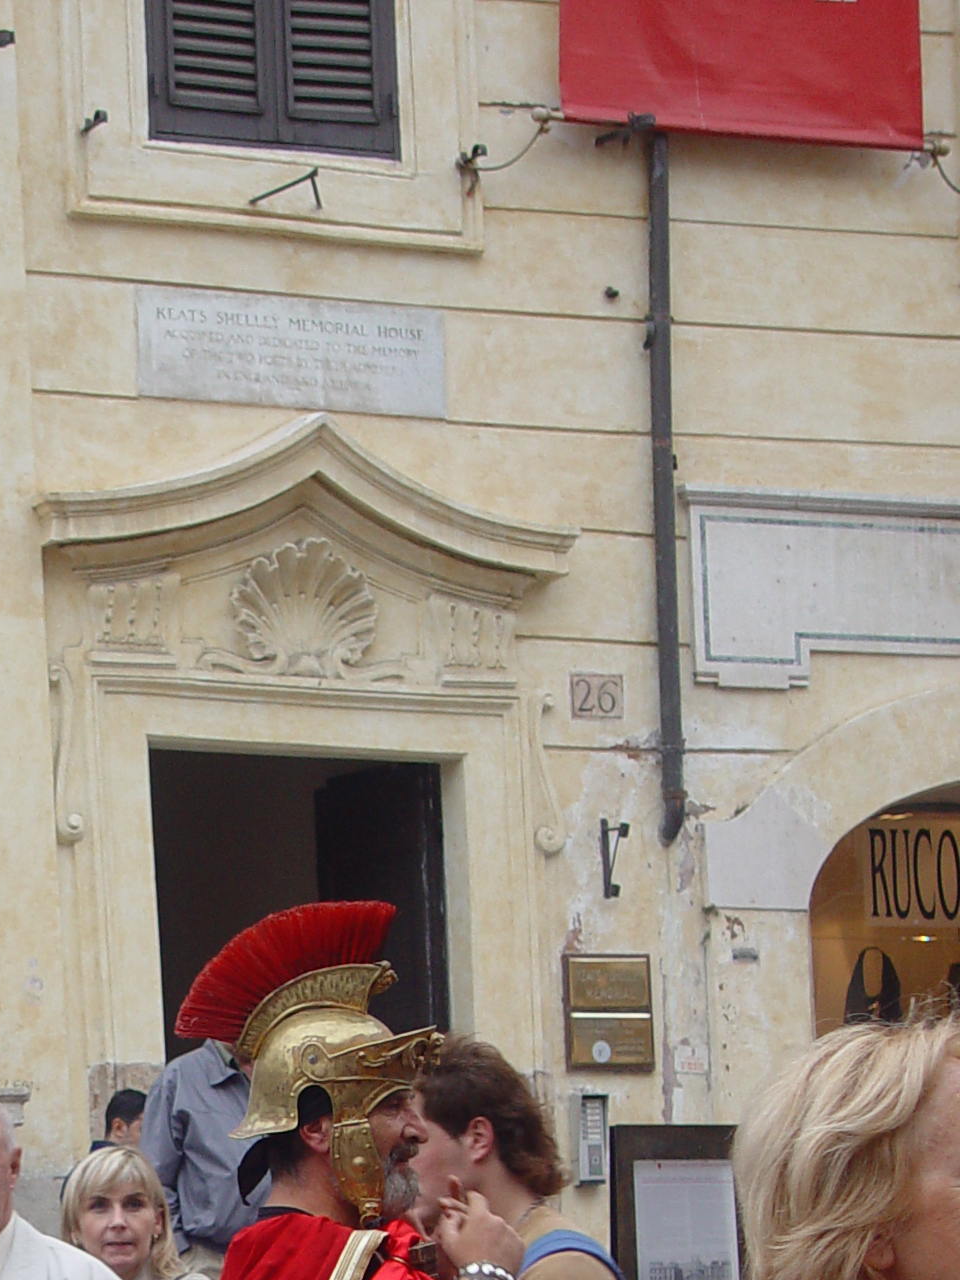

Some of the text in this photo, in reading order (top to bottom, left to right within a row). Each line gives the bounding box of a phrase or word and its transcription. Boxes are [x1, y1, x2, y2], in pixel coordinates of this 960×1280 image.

[155, 307, 424, 341] KEATS SHELLEY MEMORIAL HOUSE
[228, 333, 254, 344] AND
[575, 679, 618, 713] 26
[868, 828, 960, 921] RUCO
